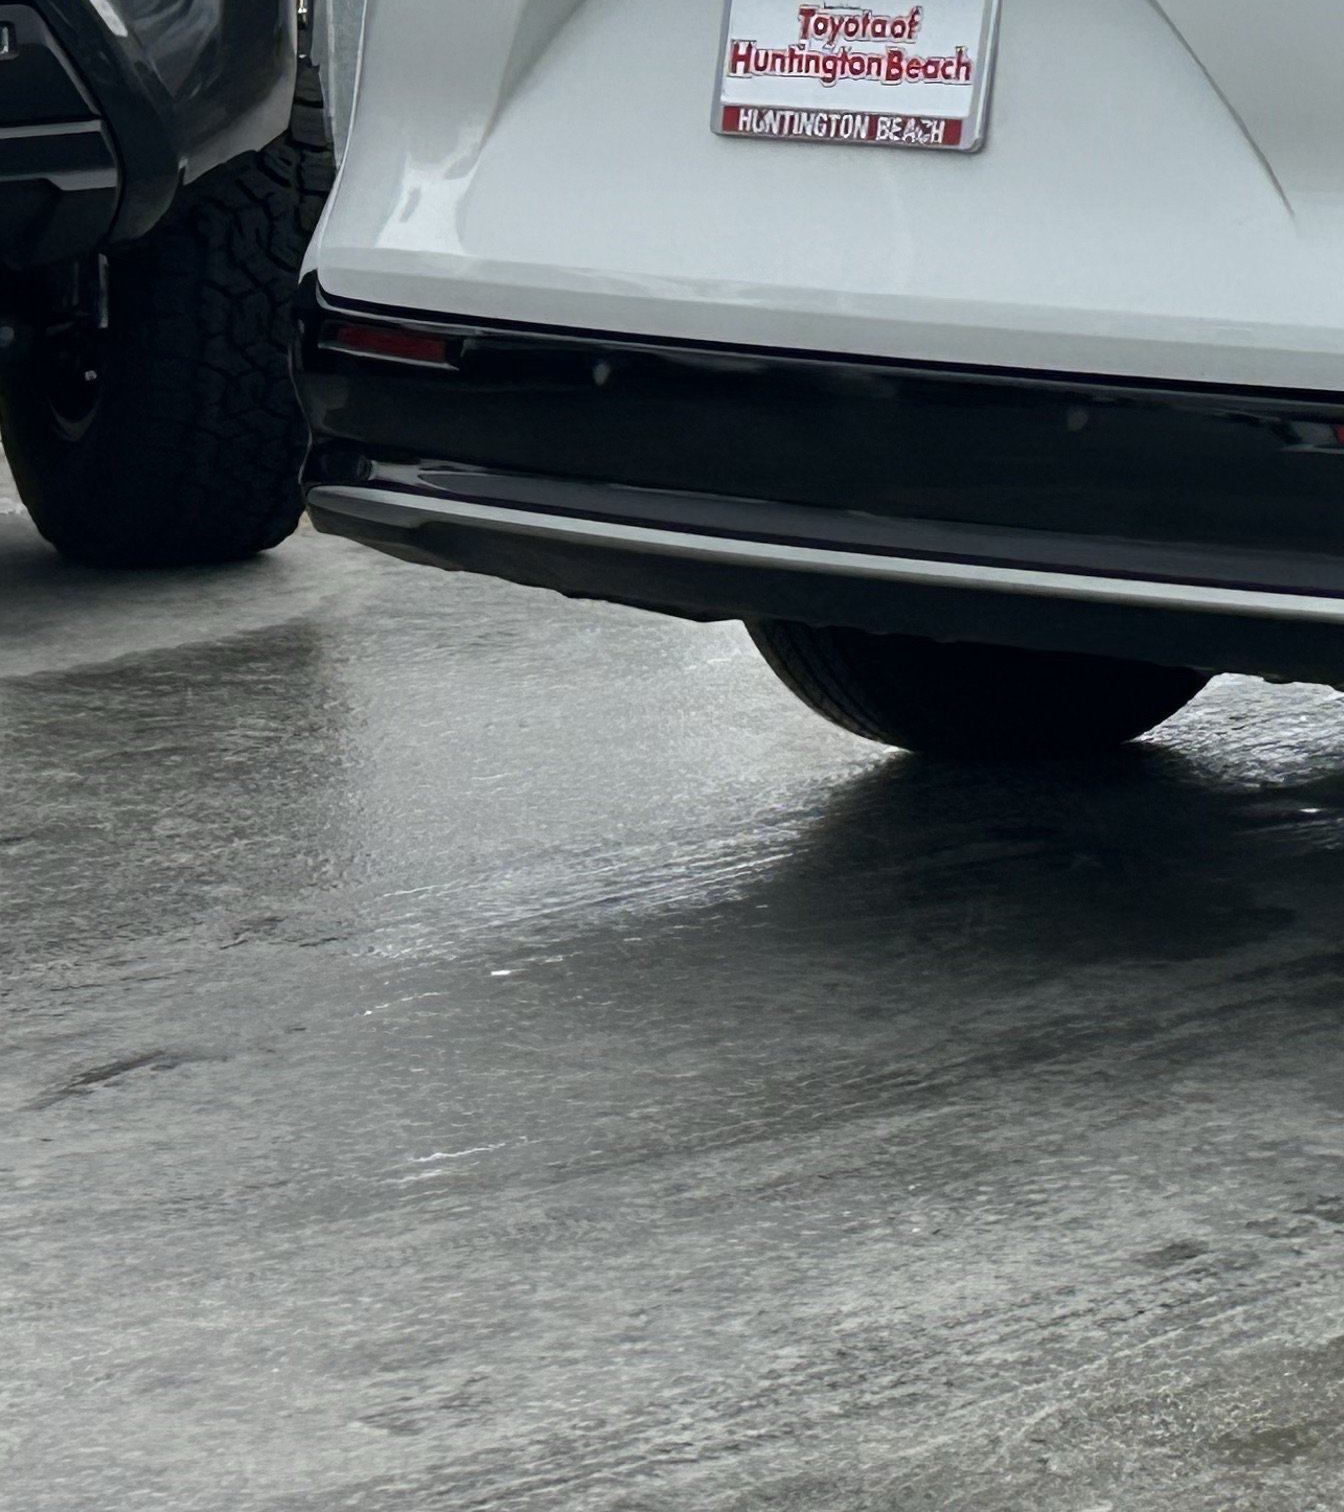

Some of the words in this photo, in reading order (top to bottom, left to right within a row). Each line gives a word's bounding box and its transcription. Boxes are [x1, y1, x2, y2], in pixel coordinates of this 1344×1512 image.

[881, 44, 972, 84] Beach
[738, 108, 869, 139] HUNTINGTON
[875, 116, 945, 143] BEACH
